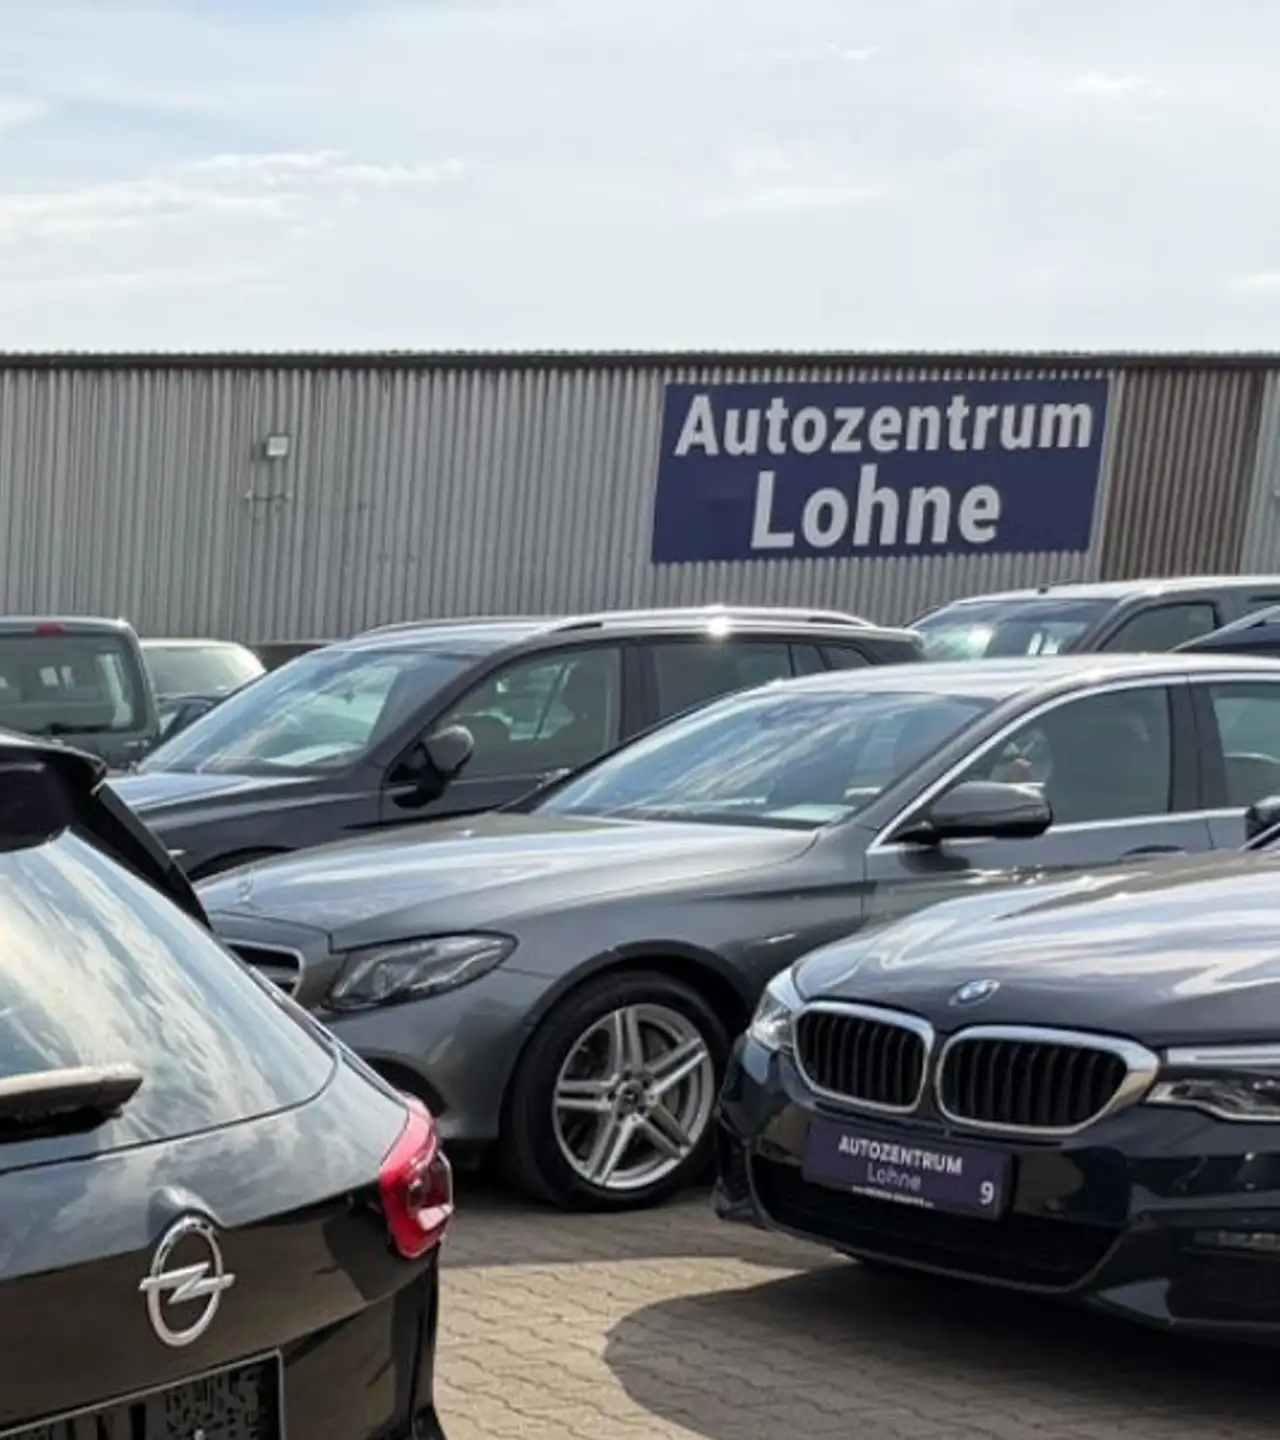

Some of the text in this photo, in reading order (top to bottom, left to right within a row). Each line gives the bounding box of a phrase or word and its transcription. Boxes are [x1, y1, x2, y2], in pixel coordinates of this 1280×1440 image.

[674, 394, 1093, 456] Autozentrum
[750, 464, 1002, 549] Lohne
[838, 1134, 963, 1175] AUTOZENTRUM
[979, 1181, 994, 1206] 9
